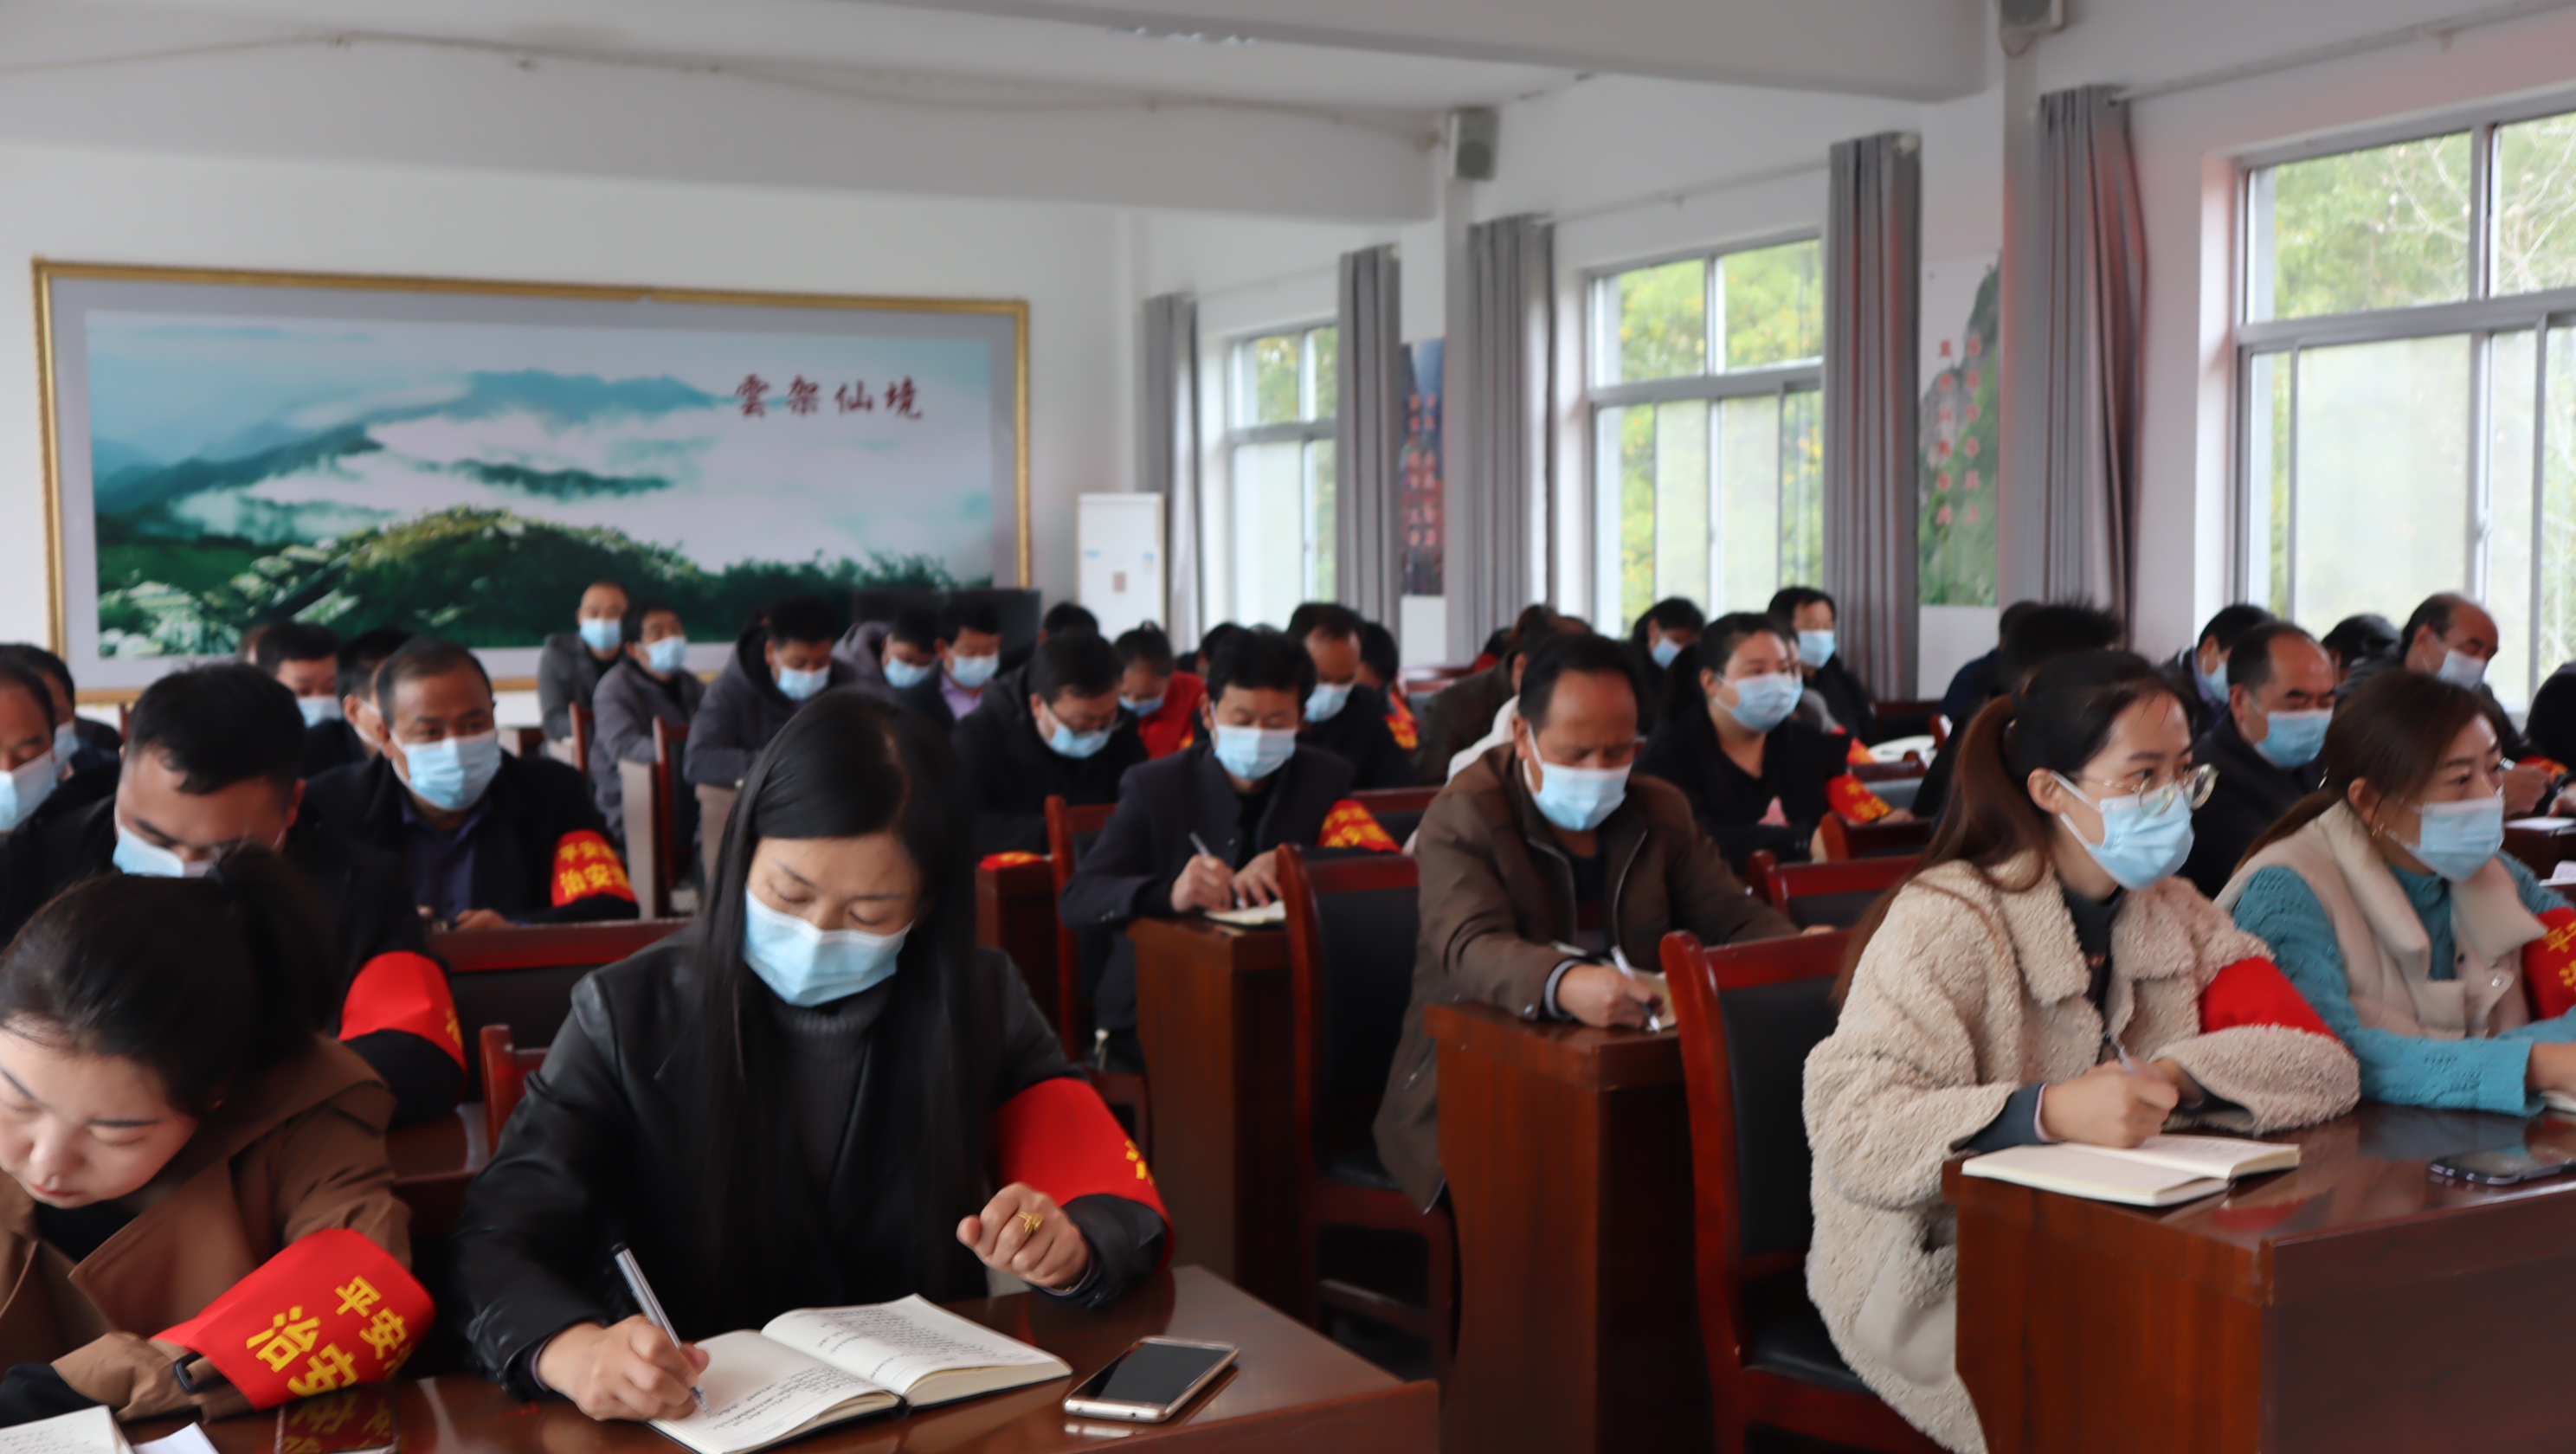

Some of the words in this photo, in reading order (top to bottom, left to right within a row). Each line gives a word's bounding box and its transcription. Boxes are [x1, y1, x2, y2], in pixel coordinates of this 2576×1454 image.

[736, 373, 923, 421] 雲架仙境
[558, 840, 618, 863] 平安
